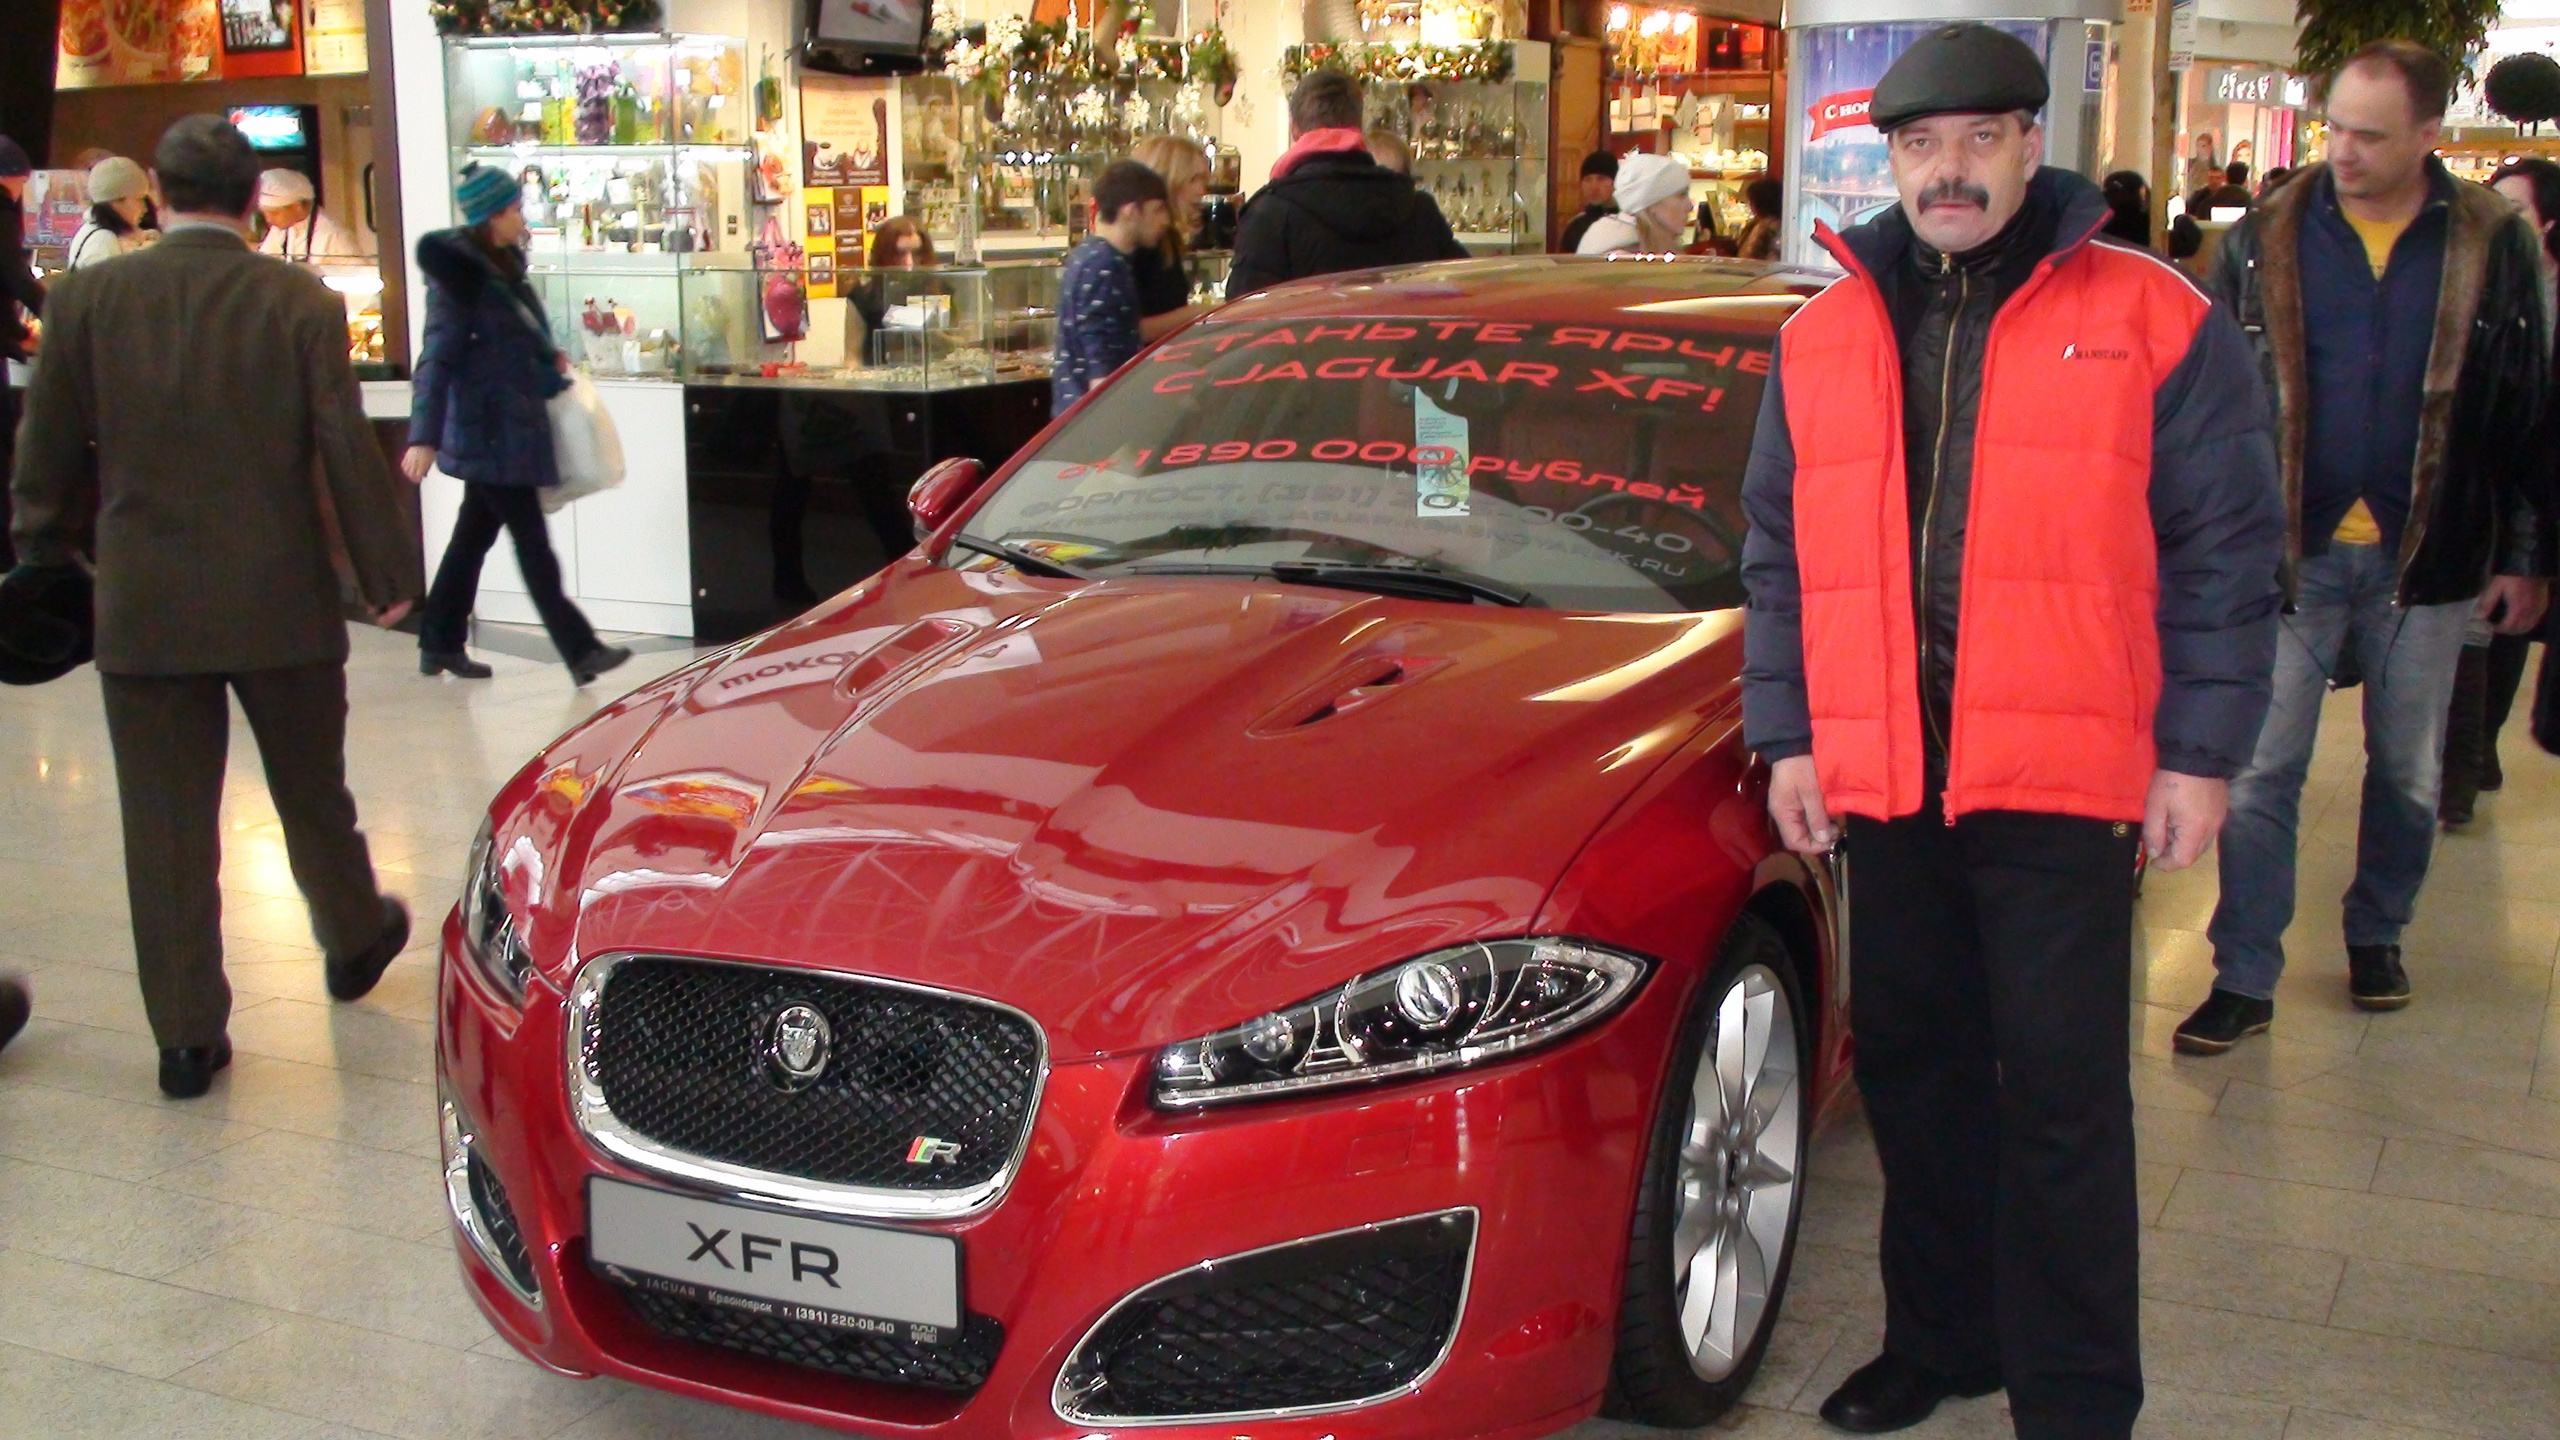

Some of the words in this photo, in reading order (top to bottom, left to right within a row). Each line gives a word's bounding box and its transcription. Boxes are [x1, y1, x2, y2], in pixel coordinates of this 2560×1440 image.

[1153, 321, 1533, 362] СТАНЬТЕ
[1547, 327, 1773, 375] ЯРЧЕ
[1153, 369, 1207, 394] С
[1213, 357, 1559, 387] JAGUAR
[1575, 369, 1724, 411] XF!
[1057, 459, 1119, 479] от
[1465, 456, 1706, 509] рублей
[686, 1221, 842, 1289] XFR
[646, 1277, 696, 1297] JAGUAR
[708, 1290, 773, 1313] Красноярск
[796, 1307, 828, 1325] (391)
